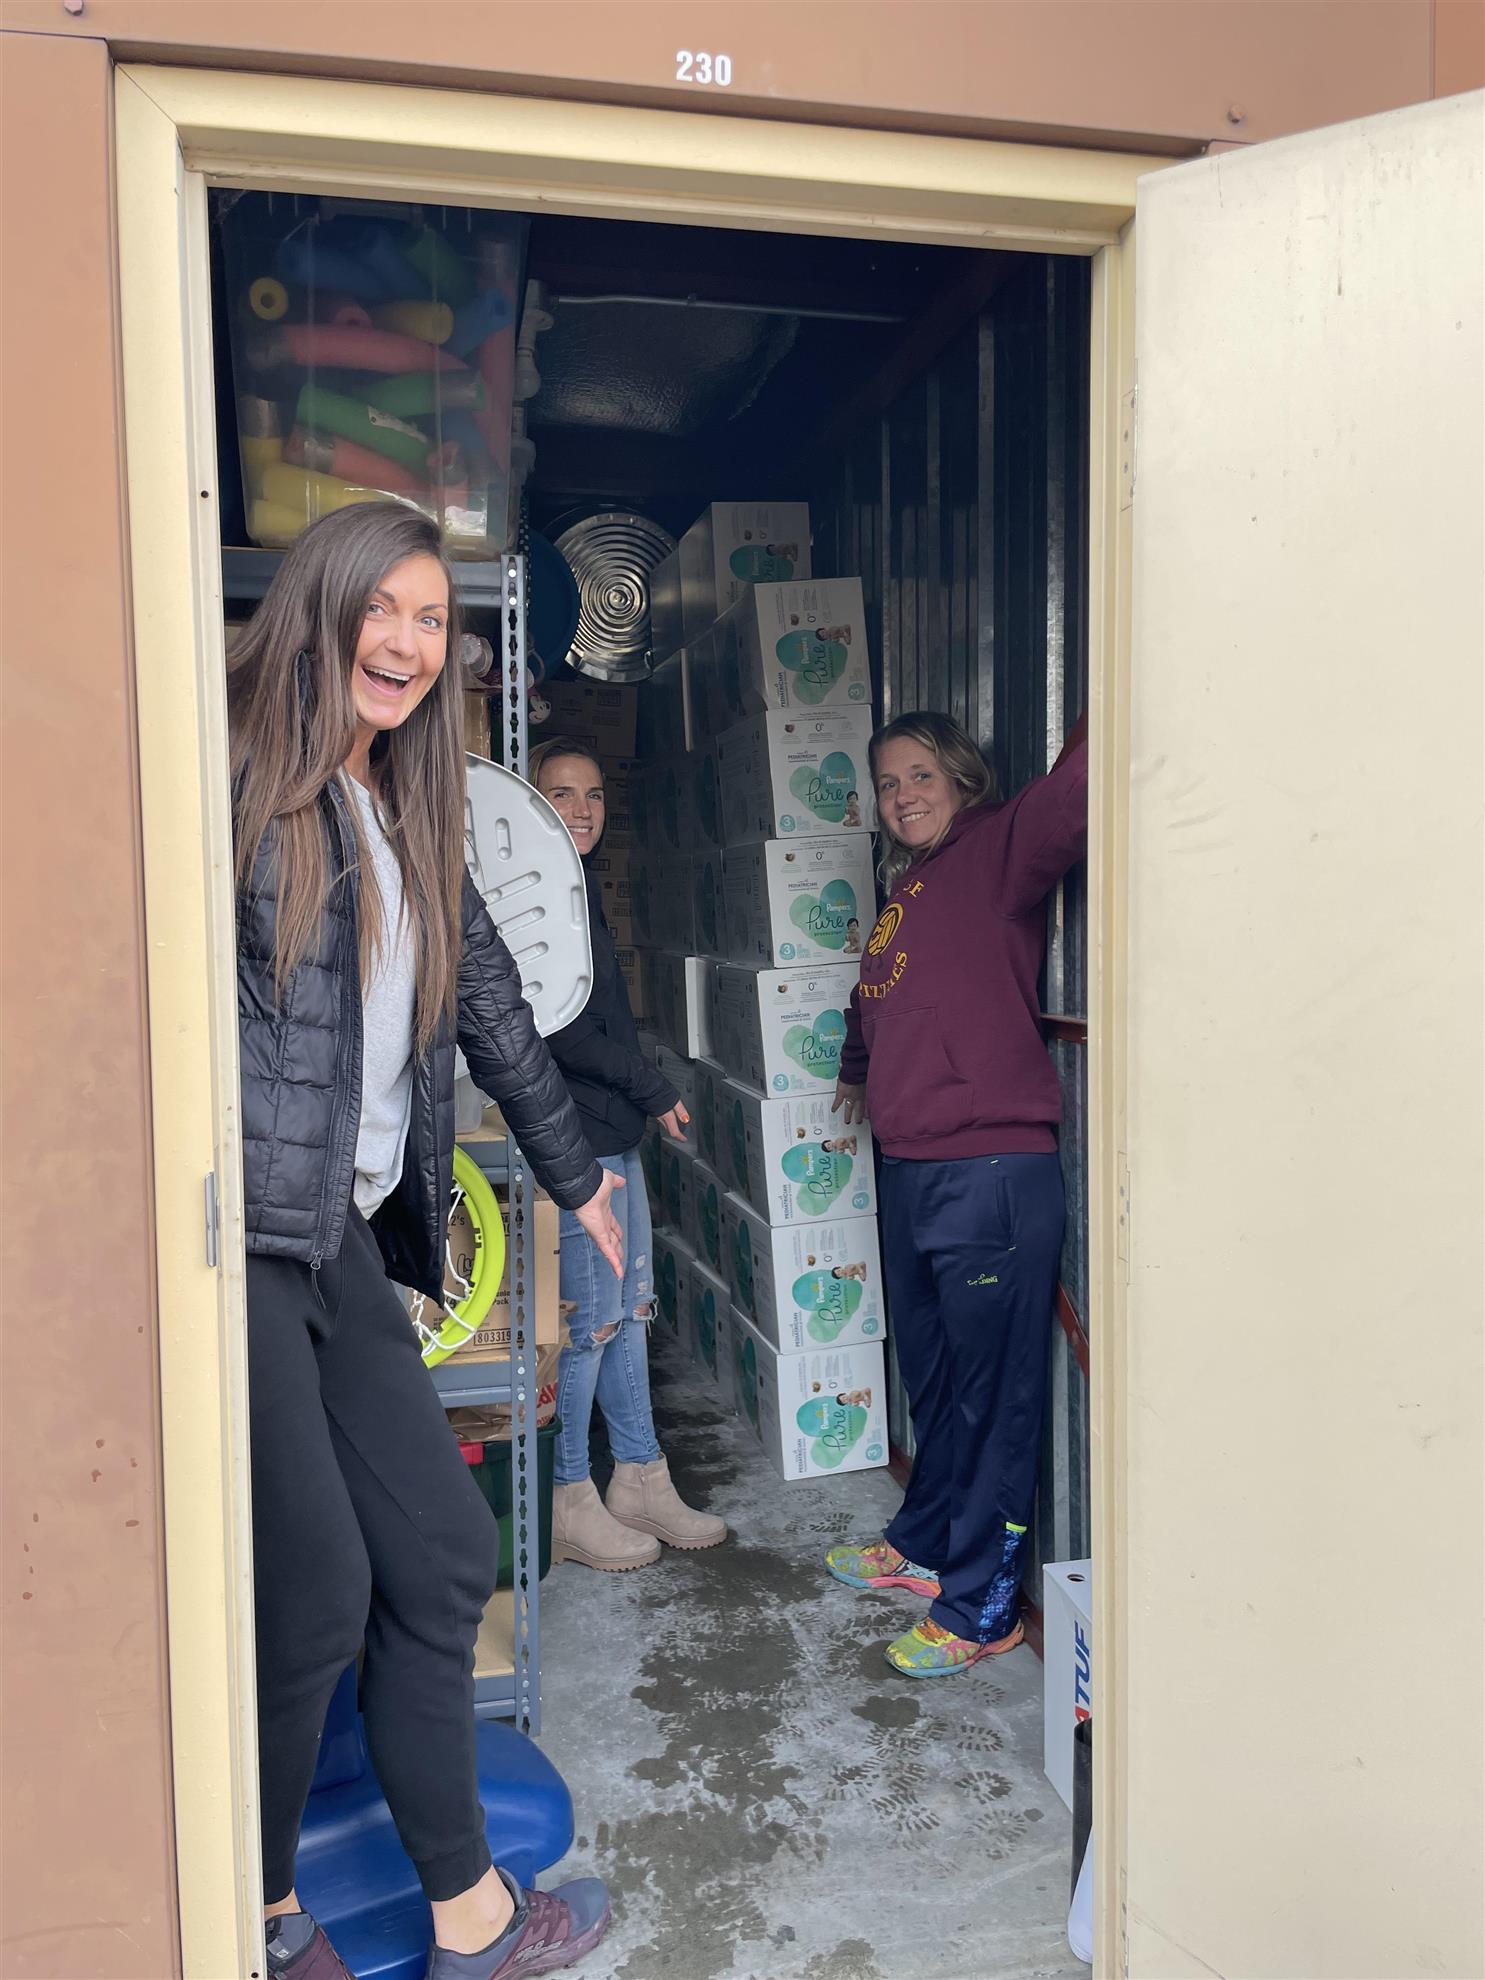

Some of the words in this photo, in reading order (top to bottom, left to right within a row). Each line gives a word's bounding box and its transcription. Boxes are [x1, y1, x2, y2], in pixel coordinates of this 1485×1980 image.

[676, 50, 732, 86] 230
[803, 644, 829, 688] Pure
[805, 777, 845, 803] Pure
[806, 905, 845, 931] Pure
[783, 944, 791, 955] 3
[800, 1035, 838, 1061] Pure
[776, 1076, 784, 1086] 3
[808, 1156, 833, 1198] Pure
[818, 1282, 843, 1325] Pure
[822, 1409, 847, 1451] Pure
